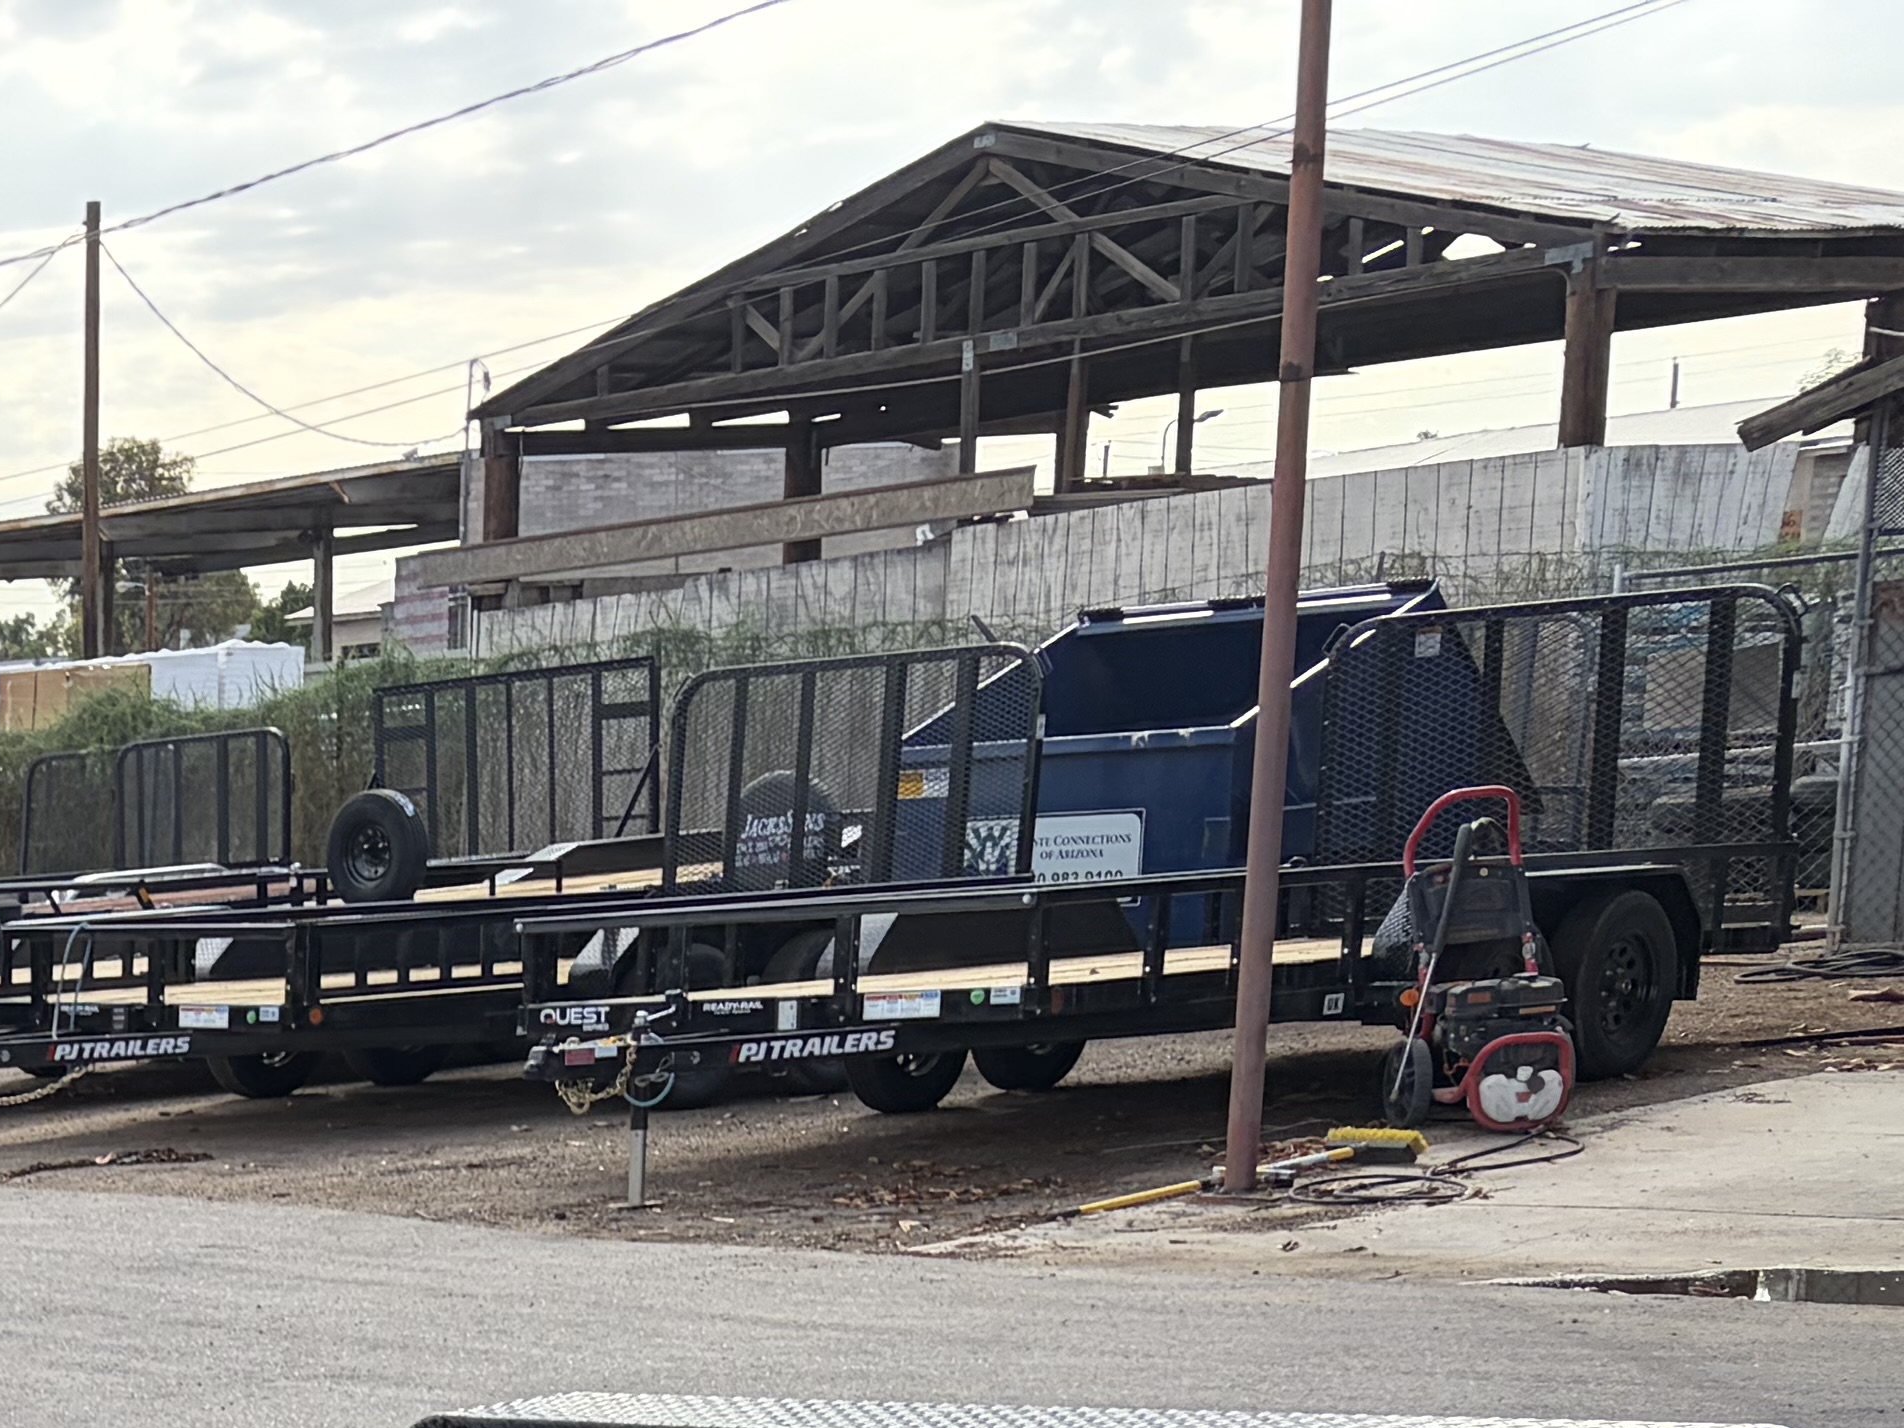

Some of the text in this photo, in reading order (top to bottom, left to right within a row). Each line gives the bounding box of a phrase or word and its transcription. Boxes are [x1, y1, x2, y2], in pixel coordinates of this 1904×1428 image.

[1053, 833, 1132, 847] CONNECTIONS
[1056, 848, 1104, 860] ARIZONA
[540, 1006, 610, 1025] QUEST
